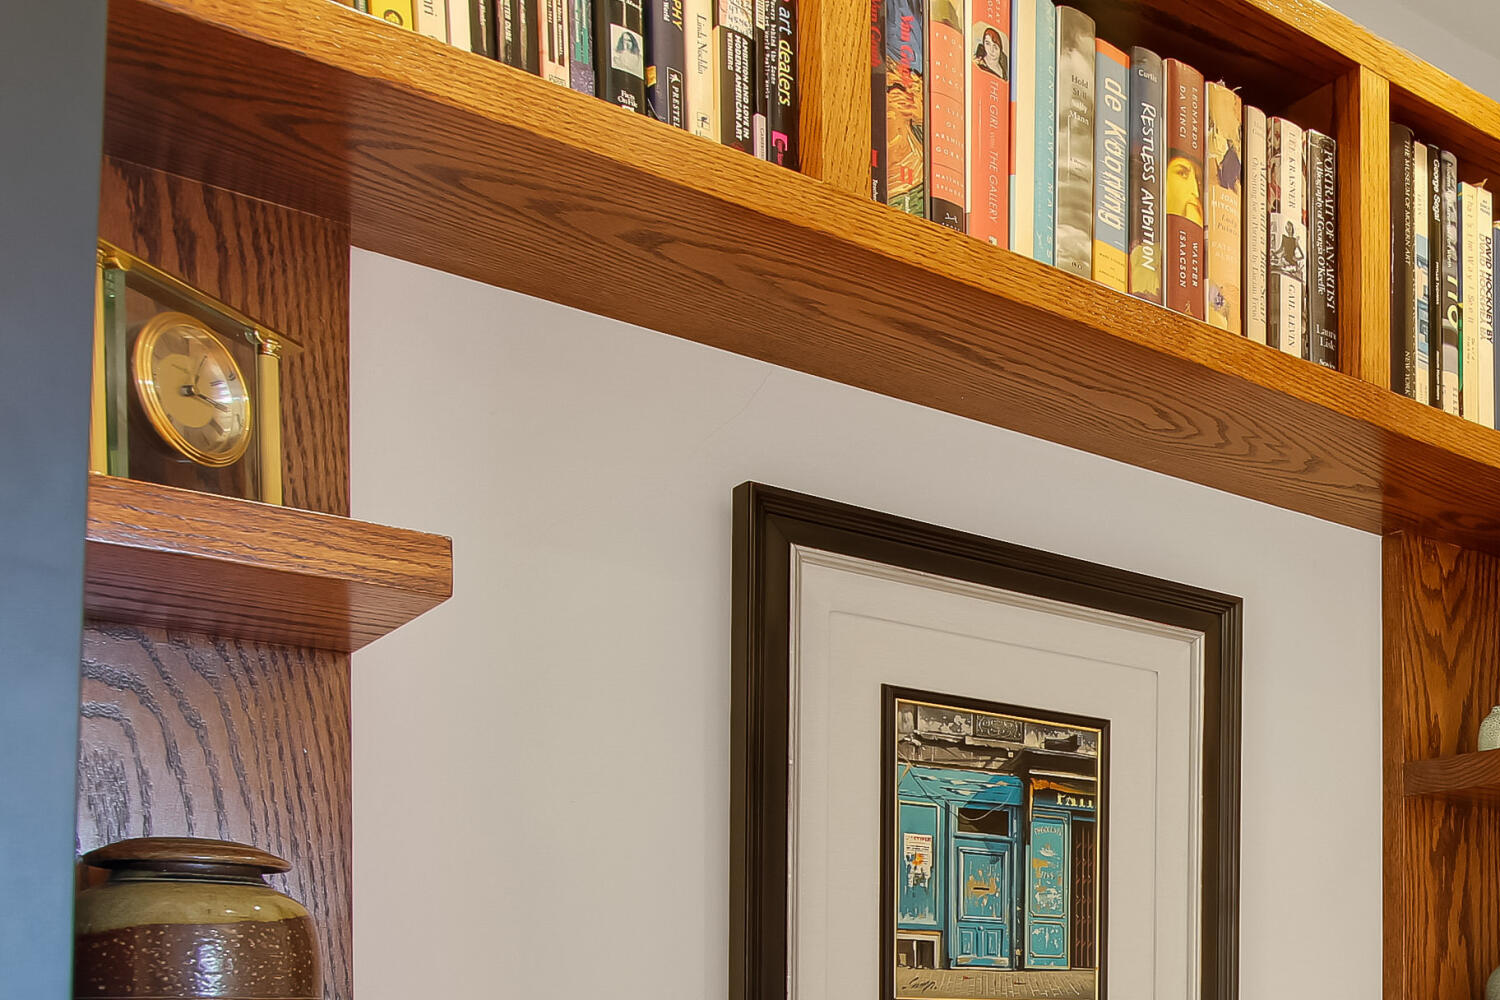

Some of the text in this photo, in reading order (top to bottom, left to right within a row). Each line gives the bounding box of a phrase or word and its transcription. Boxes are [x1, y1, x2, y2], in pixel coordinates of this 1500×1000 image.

[900, 15, 915, 42] Van
[741, 38, 749, 81] AMBITION
[779, 6, 793, 107] art dealers
[1138, 69, 1159, 83] Curtis
[734, 35, 743, 141] MODERN AMERICAN ART
[741, 83, 749, 103] AND
[1071, 75, 1089, 89] Hold
[1072, 87, 1087, 100] Still
[1104, 77, 1128, 112] de
[672, 85, 681, 128] PRESTEL
[1069, 110, 1089, 125] Mann
[1179, 85, 1187, 139] DA VINCI
[1191, 86, 1199, 149] LEONARDO
[742, 127, 749, 139] IN
[988, 80, 999, 223] THE GIRL THE GALLERY
[1140, 101, 1157, 272] RESTLESS AMBITION
[1288, 157, 1296, 209] KRASNER
[1432, 159, 1440, 221] George Segal
[1047, 182, 1055, 258] MATISS
[1323, 148, 1336, 313] PORTRAIT OF AN ARTIST
[1179, 230, 1187, 288] ISAACSON
[1191, 242, 1199, 287] WALTER
[1485, 272, 1493, 327] HOCKNEY
[1486, 329, 1493, 343] BY
